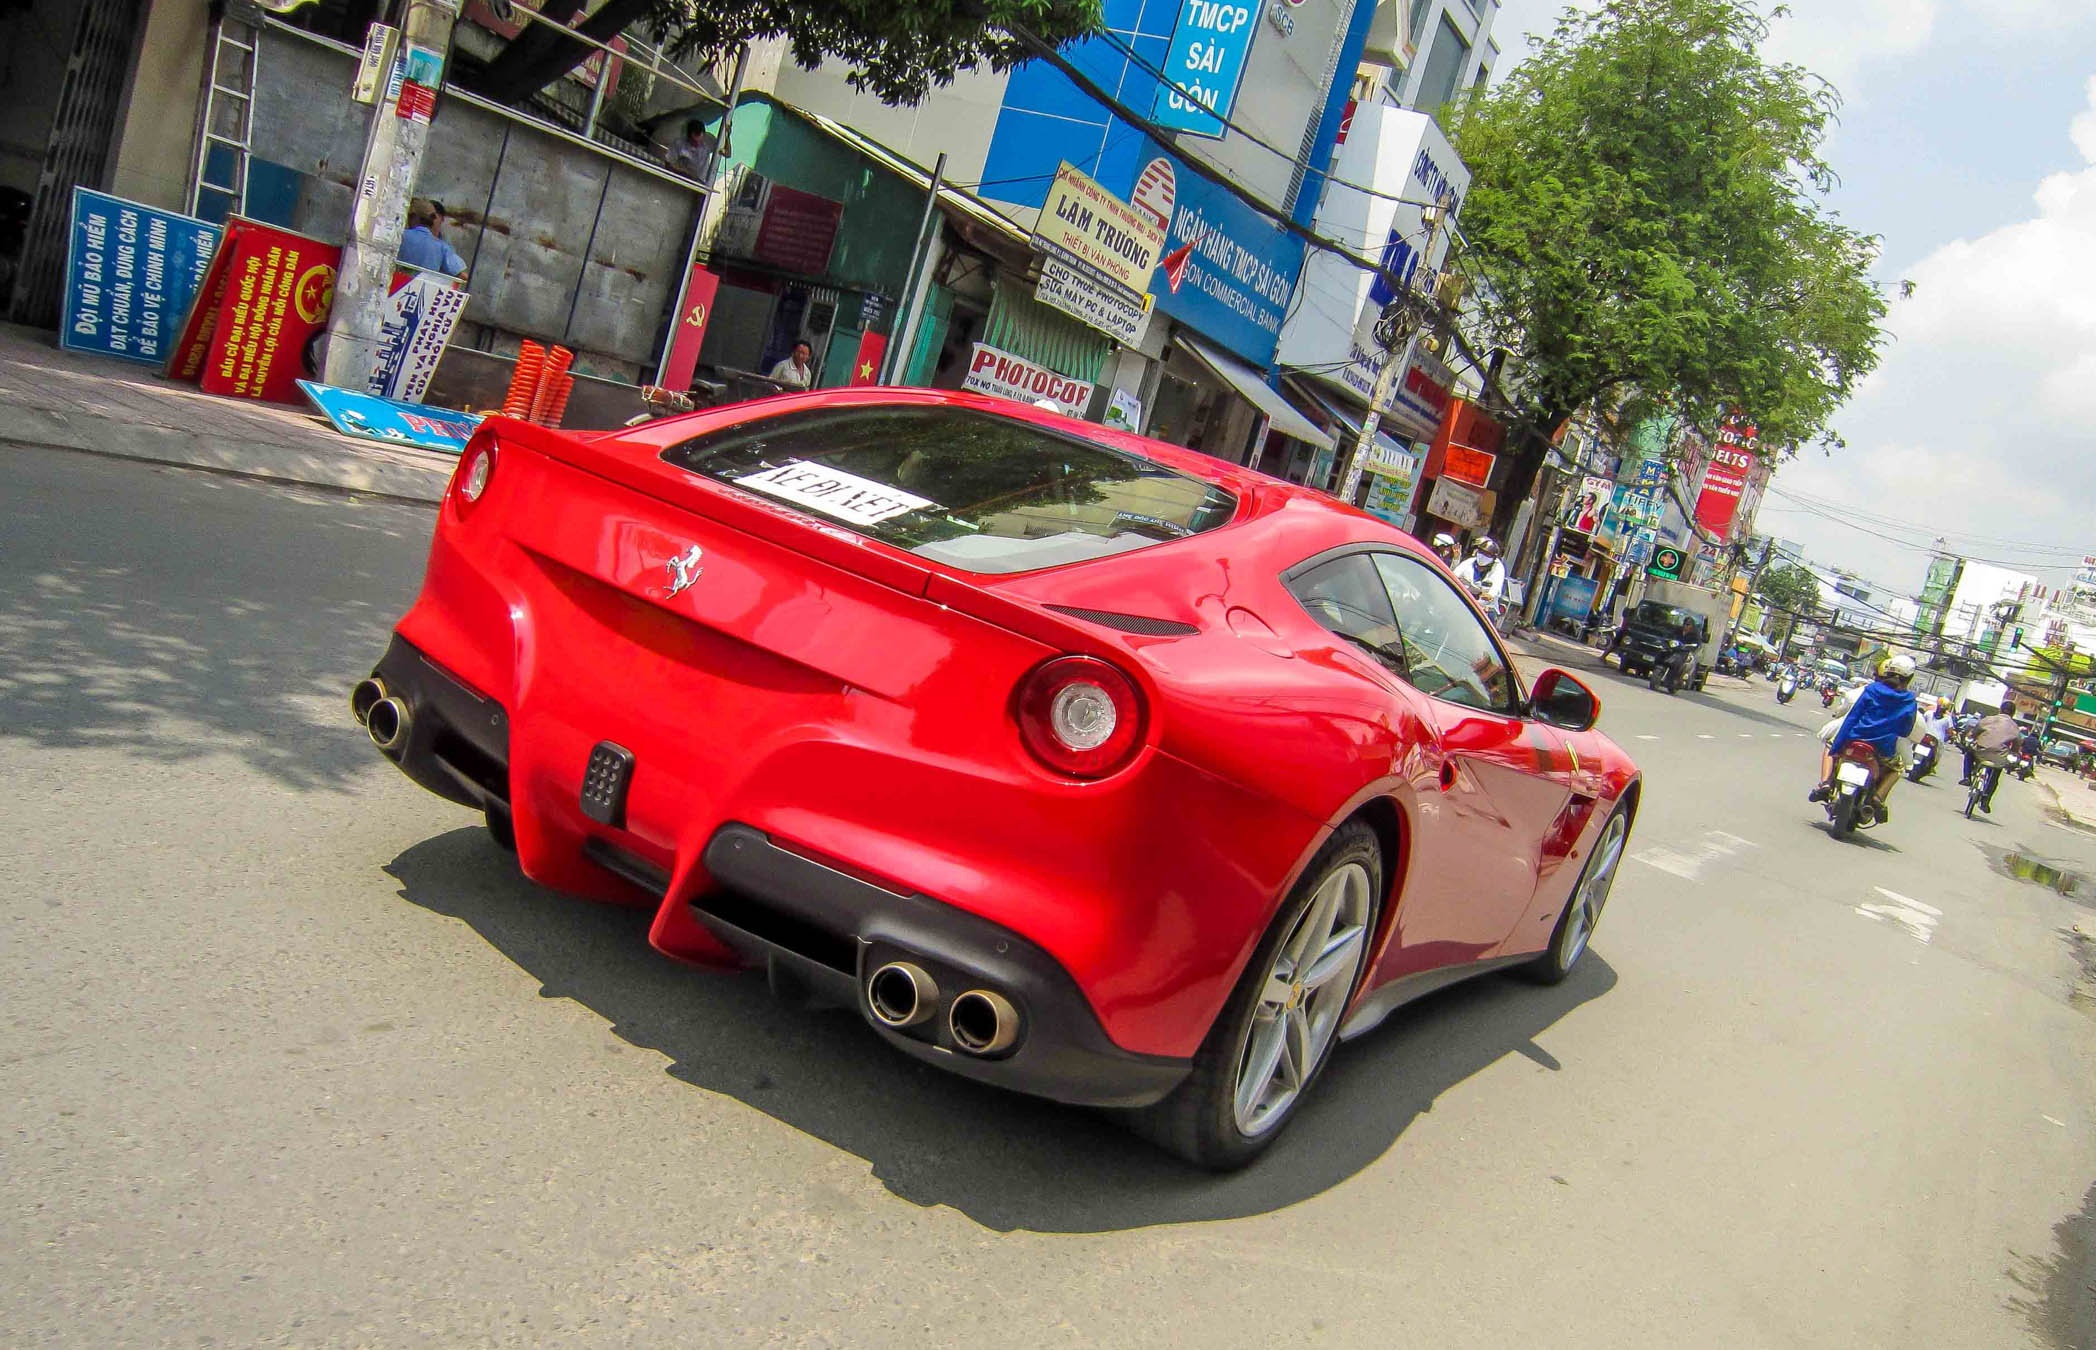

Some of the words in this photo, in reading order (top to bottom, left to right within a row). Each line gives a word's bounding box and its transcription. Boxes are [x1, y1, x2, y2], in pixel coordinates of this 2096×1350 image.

[1188, 0, 1248, 33] TMCP
[1275, 6, 1295, 36] SCB
[1186, 38, 1225, 74] SÀI
[1168, 79, 1218, 113] GÒN
[1085, 183, 1101, 202] CÔNG
[115, 209, 138, 244] CÁCH
[1055, 194, 1094, 233] LÂM
[79, 213, 107, 251] HIỂM
[145, 217, 168, 251] MÌNH
[189, 229, 214, 259] HIỂM
[78, 252, 103, 282] BẢO
[112, 245, 135, 279] ĐÚNG
[246, 255, 263, 274] HỘI
[268, 246, 282, 267] DÂN
[285, 250, 299, 270] DÂN
[1062, 230, 1083, 251] THIẾT
[1082, 243, 1090, 258] BỊ
[1106, 258, 1130, 281] PHÒNG
[1173, 207, 1206, 253] NGÂN
[1204, 224, 1233, 271] HÀNG
[1232, 246, 1258, 286] TMCP
[1255, 258, 1272, 297] SÀI
[1271, 271, 1292, 309] GÒN
[142, 251, 165, 291] CHÍNH
[261, 269, 277, 296] NHÂN
[278, 271, 294, 298] CÔNG
[78, 283, 101, 306] MŨ
[141, 292, 166, 309] VỆ
[239, 274, 256, 301] QUỐC
[1049, 264, 1068, 281] CHO
[1096, 285, 1144, 321] PHOTOCOPY
[232, 303, 249, 325] BIỂU
[251, 295, 270, 322] ĐỒNG
[450, 293, 464, 313] TRI
[1084, 298, 1098, 313] PC
[1098, 306, 1106, 317] &
[1107, 311, 1137, 334] LAPTOP
[1202, 273, 1257, 323] COMMERCIAL
[1257, 308, 1281, 334] BANK
[75, 308, 104, 335] ĐỘI
[136, 312, 160, 338] BẢO
[230, 325, 246, 343] ĐẠI
[413, 319, 431, 354] PHÁT
[428, 287, 444, 316] HUY
[110, 325, 133, 350] ĐẠT
[239, 359, 254, 380] ĐẠI
[972, 350, 1089, 406] PHOTOCOP
[234, 377, 248, 393] VÀ
